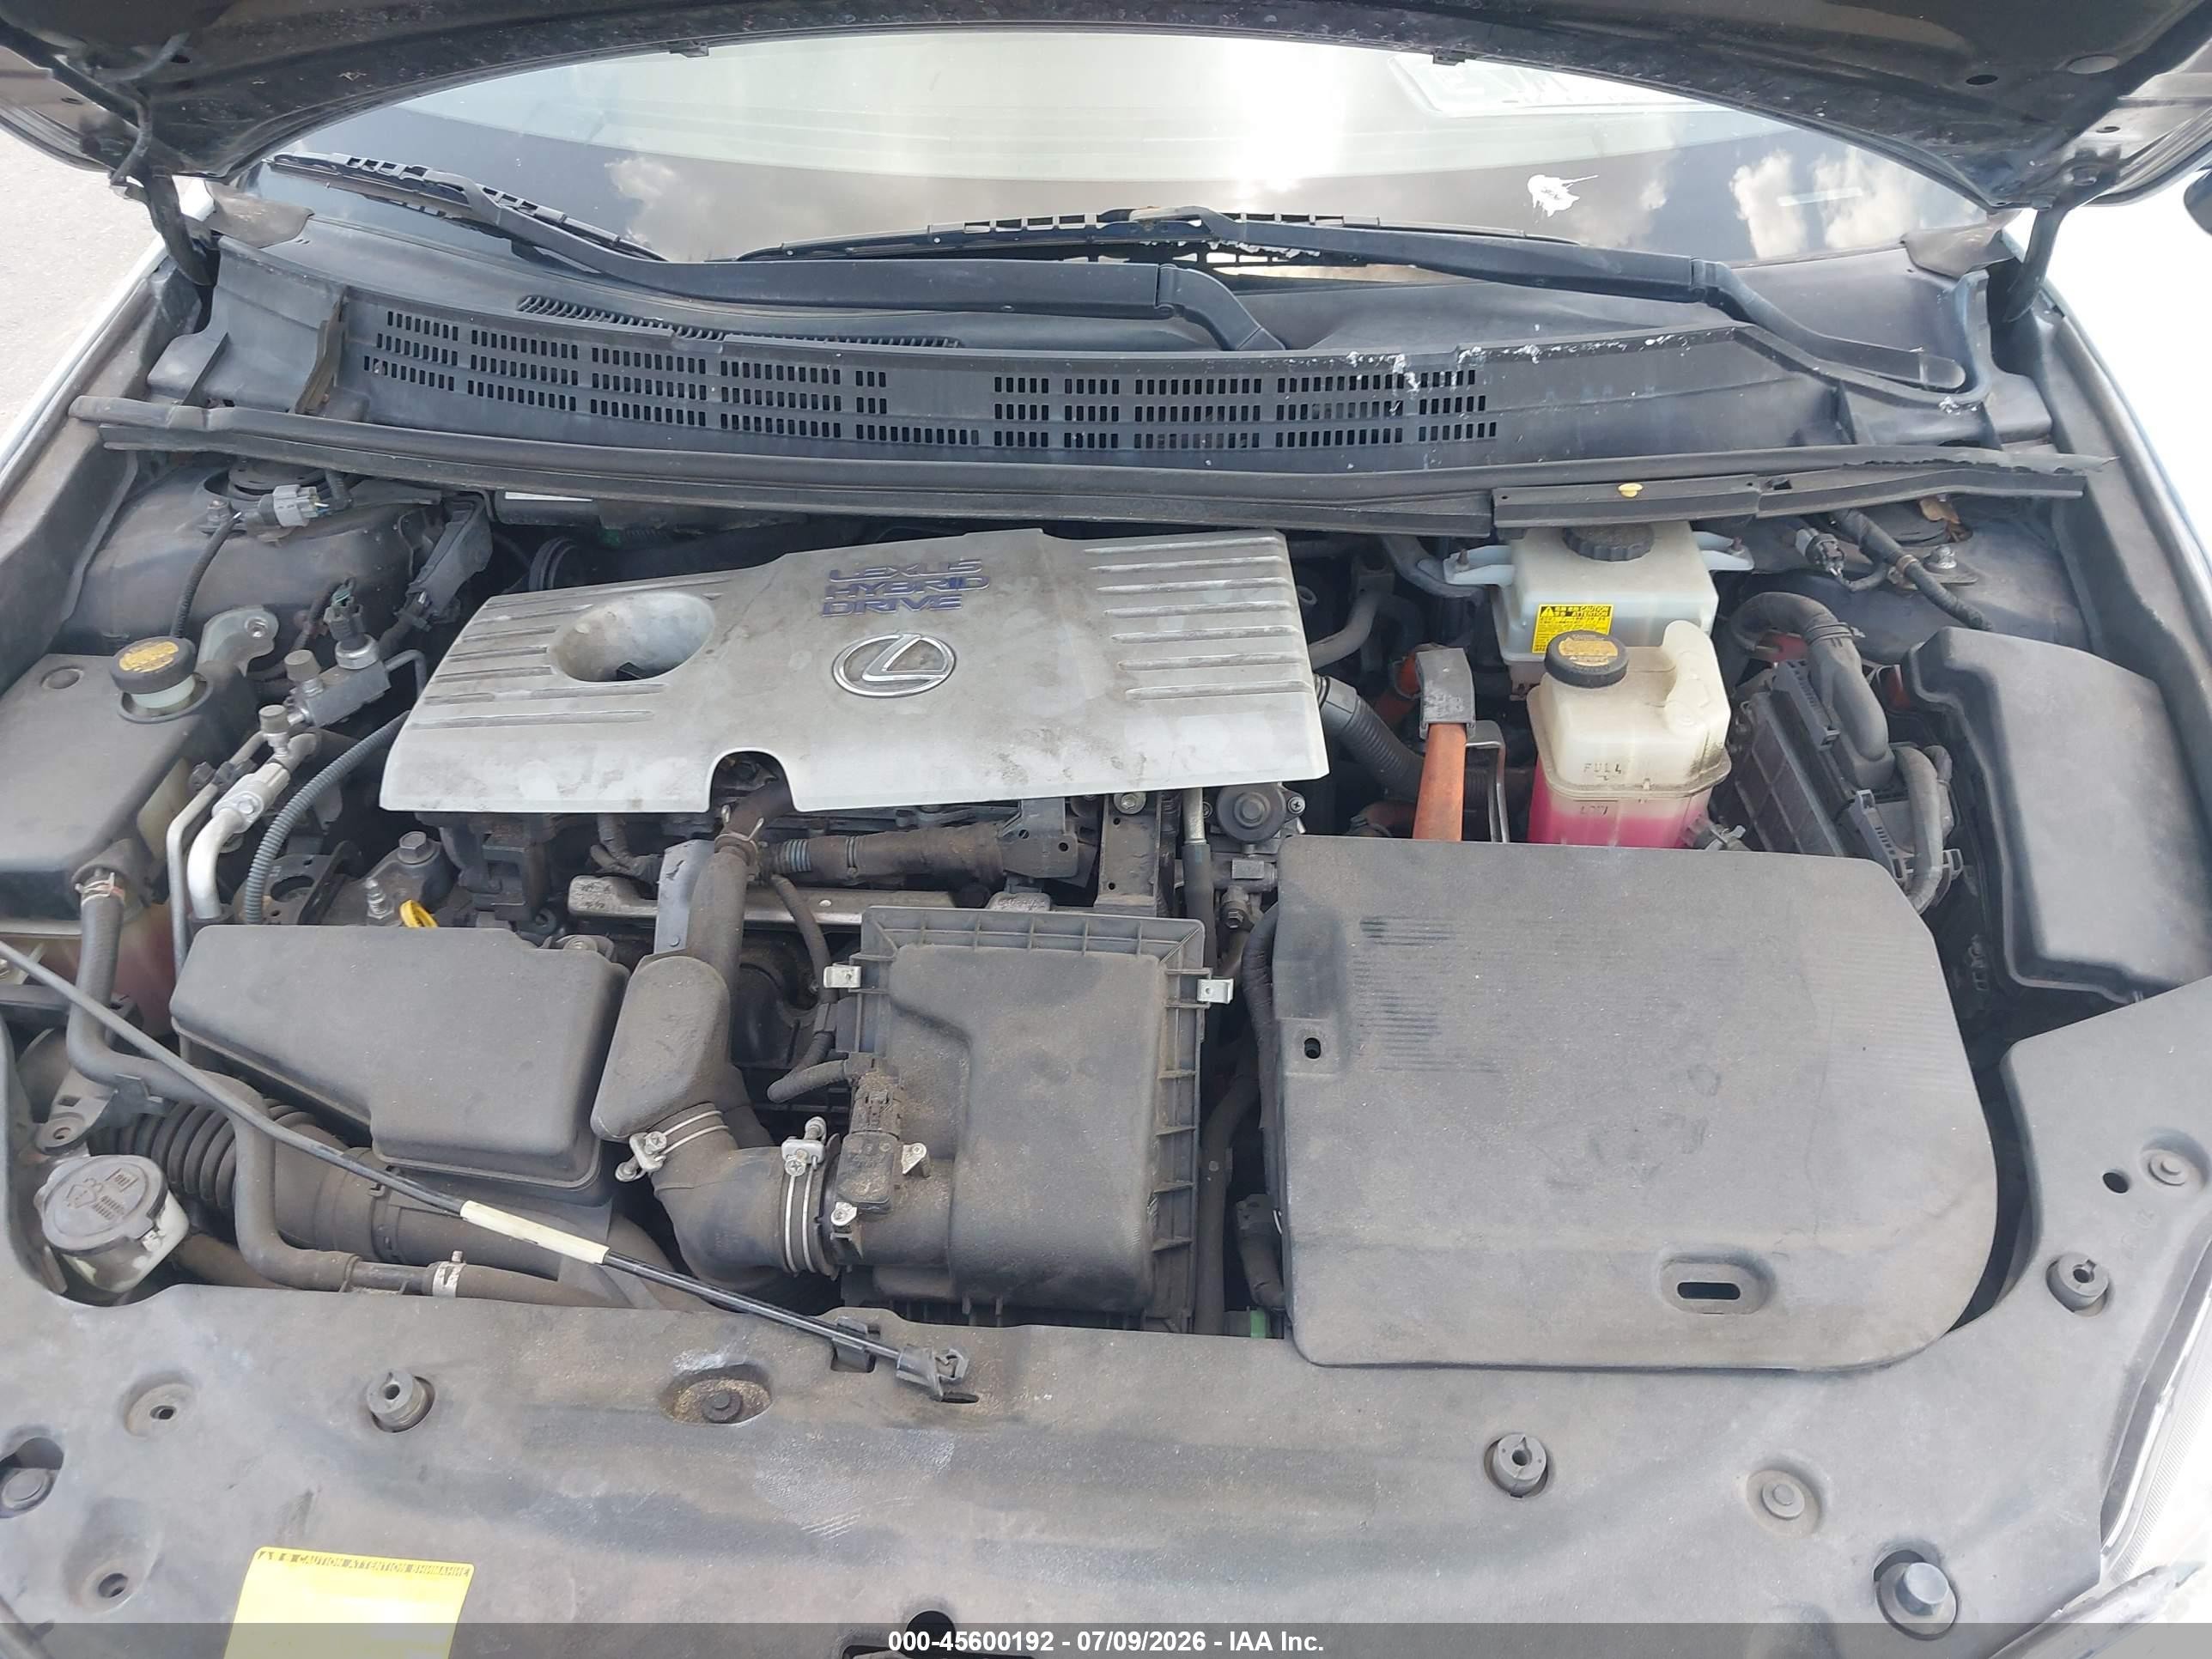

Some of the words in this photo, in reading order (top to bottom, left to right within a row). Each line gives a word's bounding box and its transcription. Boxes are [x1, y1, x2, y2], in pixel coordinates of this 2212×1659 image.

[828, 559, 983, 583] LEXUS
[825, 576, 990, 600] HYBRID
[822, 594, 963, 617] DRIVE
[297, 1553, 343, 1567] CAUTION
[348, 1558, 408, 1573] ATTENTION
